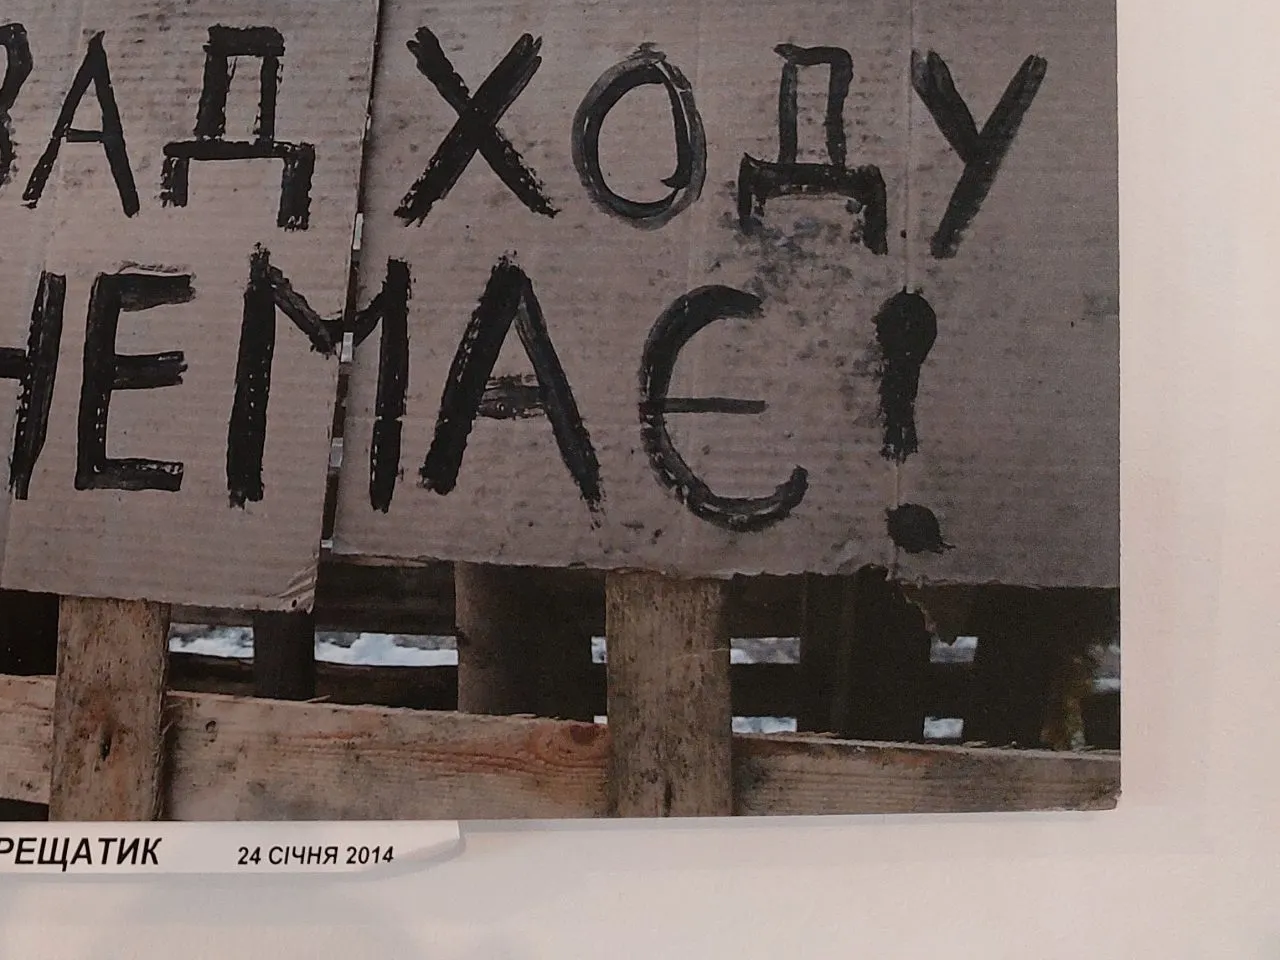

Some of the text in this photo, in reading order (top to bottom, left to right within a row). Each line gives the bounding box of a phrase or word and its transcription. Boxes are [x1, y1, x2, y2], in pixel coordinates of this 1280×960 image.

[393, 25, 1049, 260] ХОДУ
[237, 846, 262, 865] 24
[268, 845, 339, 865] СІЧНЯ
[346, 845, 394, 865] 2014
